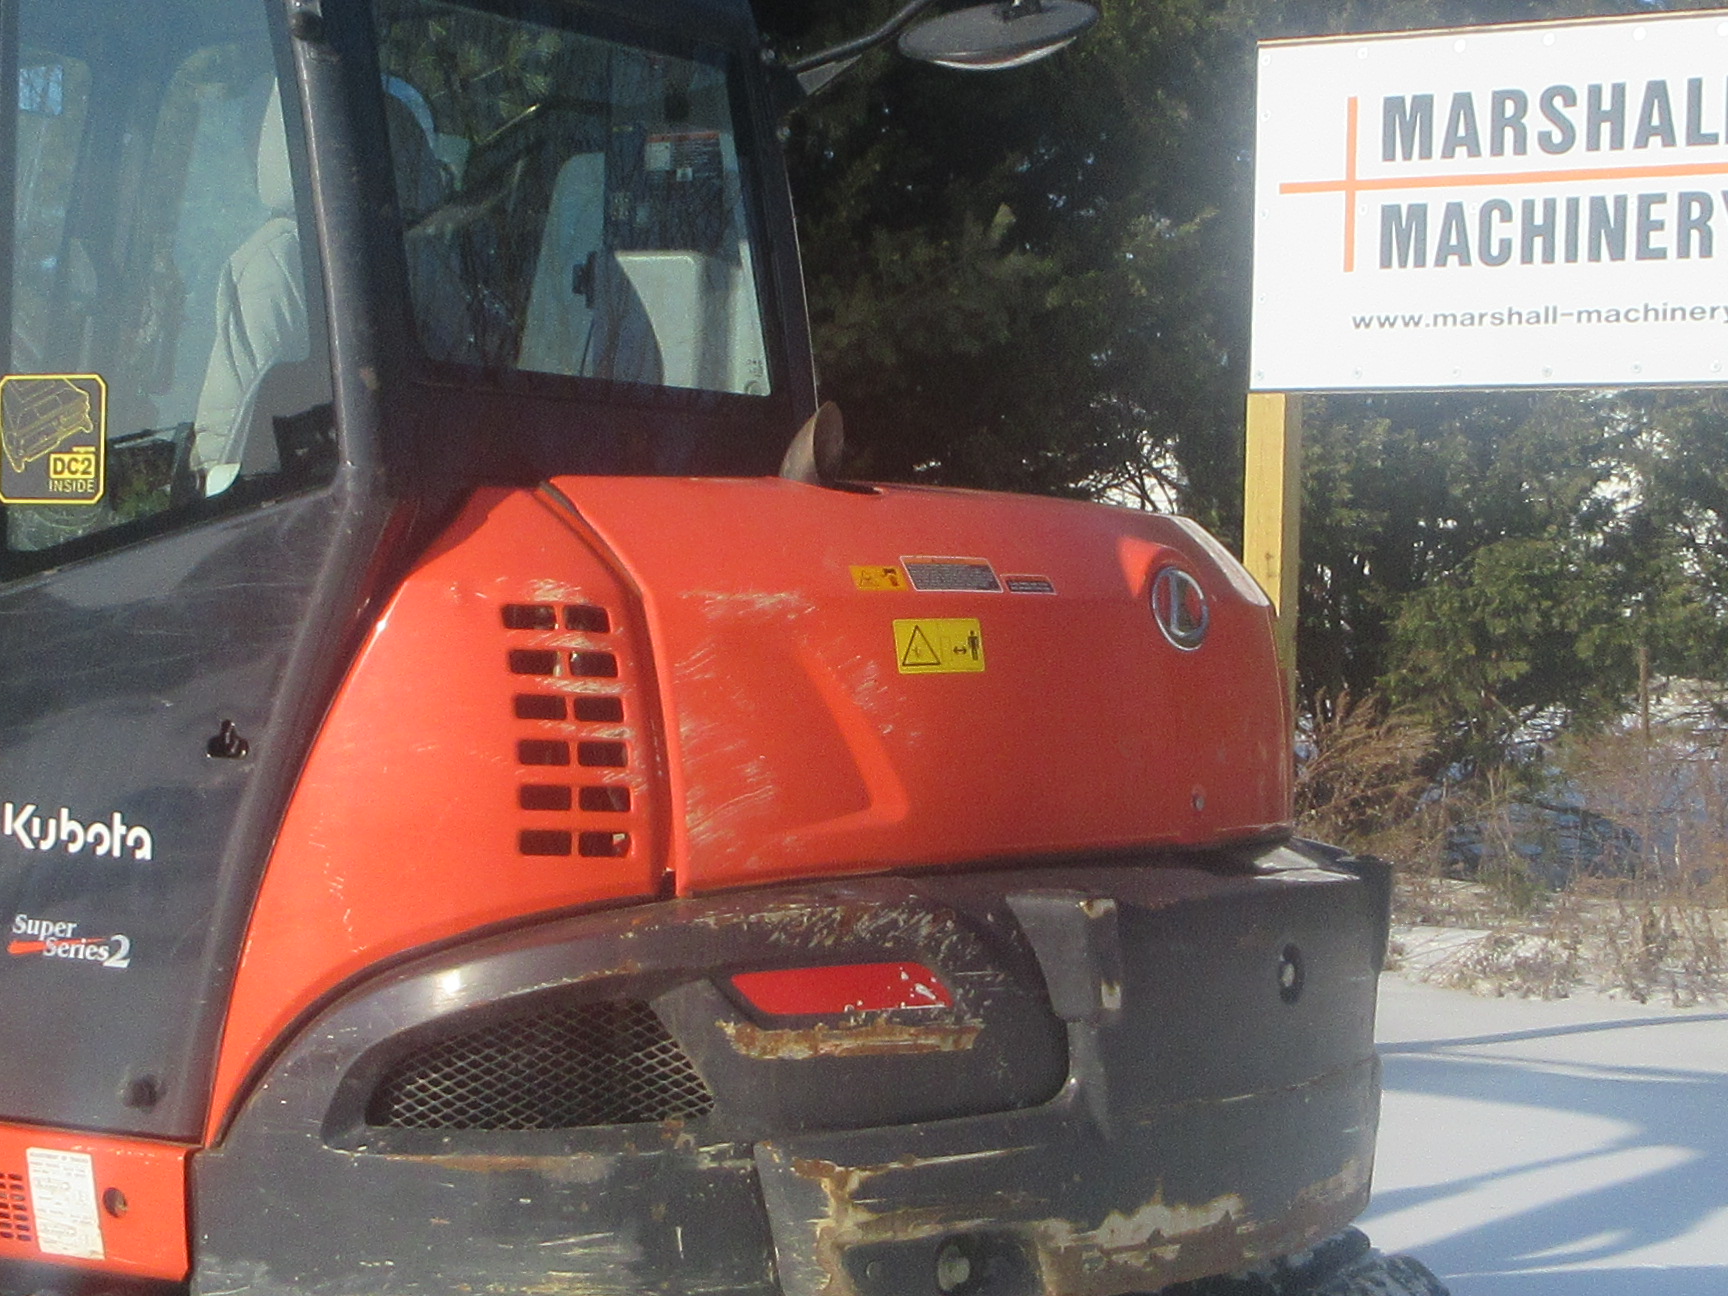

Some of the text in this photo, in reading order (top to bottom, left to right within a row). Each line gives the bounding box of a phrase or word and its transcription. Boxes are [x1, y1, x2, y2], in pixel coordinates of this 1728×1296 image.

[53, 457, 93, 475] DC2
[49, 479, 95, 493] INSIDE
[3, 802, 154, 860] Kubota
[12, 913, 78, 941] Super
